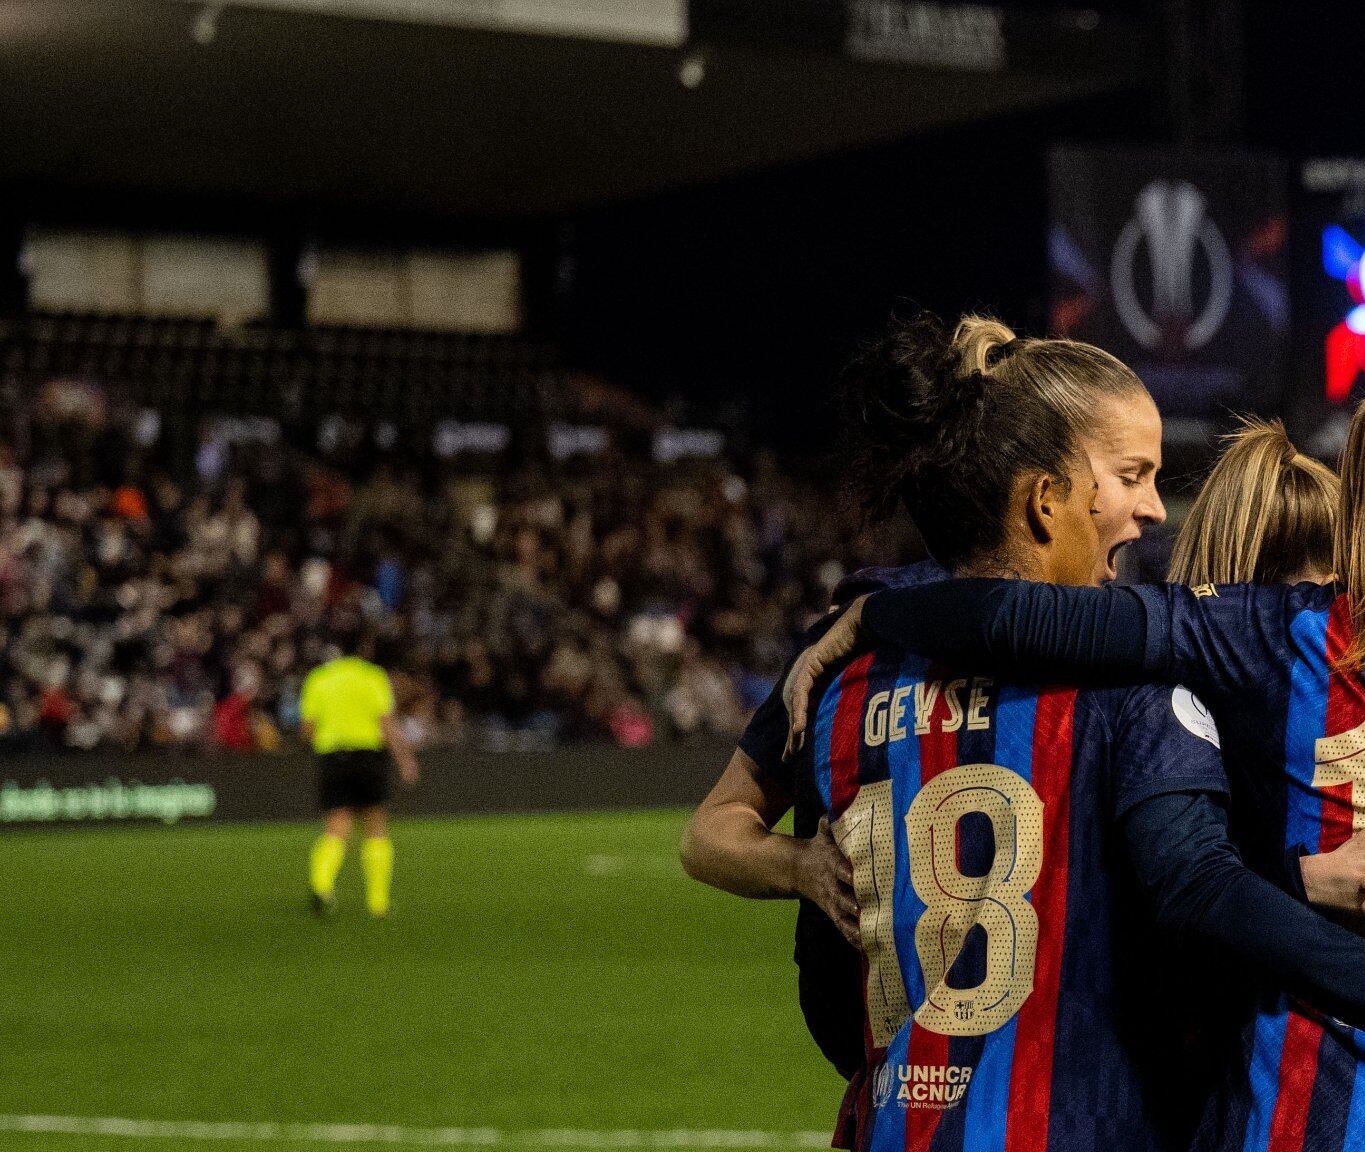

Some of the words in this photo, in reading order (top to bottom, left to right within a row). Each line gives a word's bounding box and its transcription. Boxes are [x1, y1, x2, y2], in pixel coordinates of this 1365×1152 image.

[864, 676, 994, 747] GEYSE
[829, 763, 1045, 1048] 18
[897, 1083, 967, 1101] ACNUR
[898, 1064, 973, 1083] UNHCR
